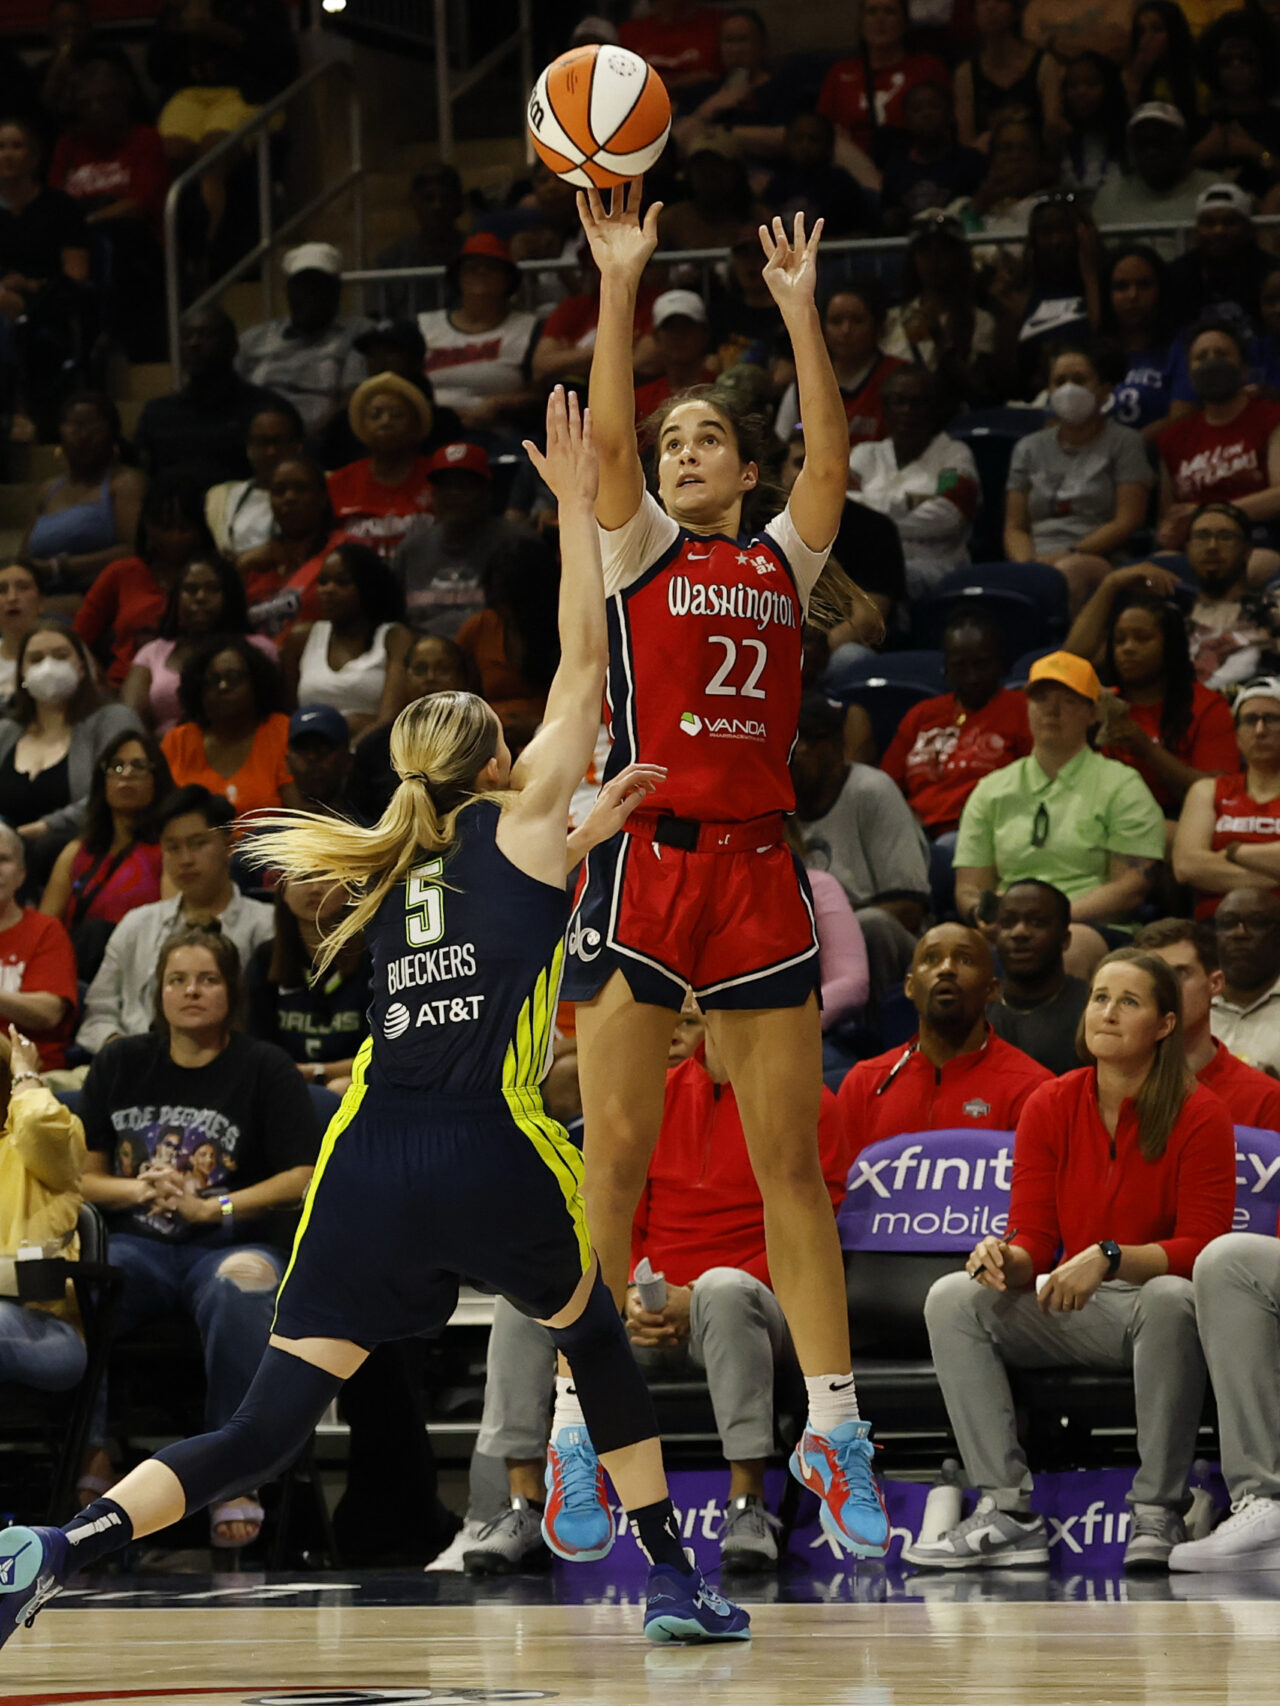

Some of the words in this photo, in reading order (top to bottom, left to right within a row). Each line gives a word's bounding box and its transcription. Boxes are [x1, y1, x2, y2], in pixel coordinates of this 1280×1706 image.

[705, 635, 768, 699] 22
[703, 717, 767, 738] VANDA
[405, 857, 445, 949] 5
[387, 943, 477, 996] BUECKERS
[415, 995, 485, 1028] AT&T
[848, 1145, 1013, 1198] xfinit
[872, 1205, 1009, 1235] mobile
